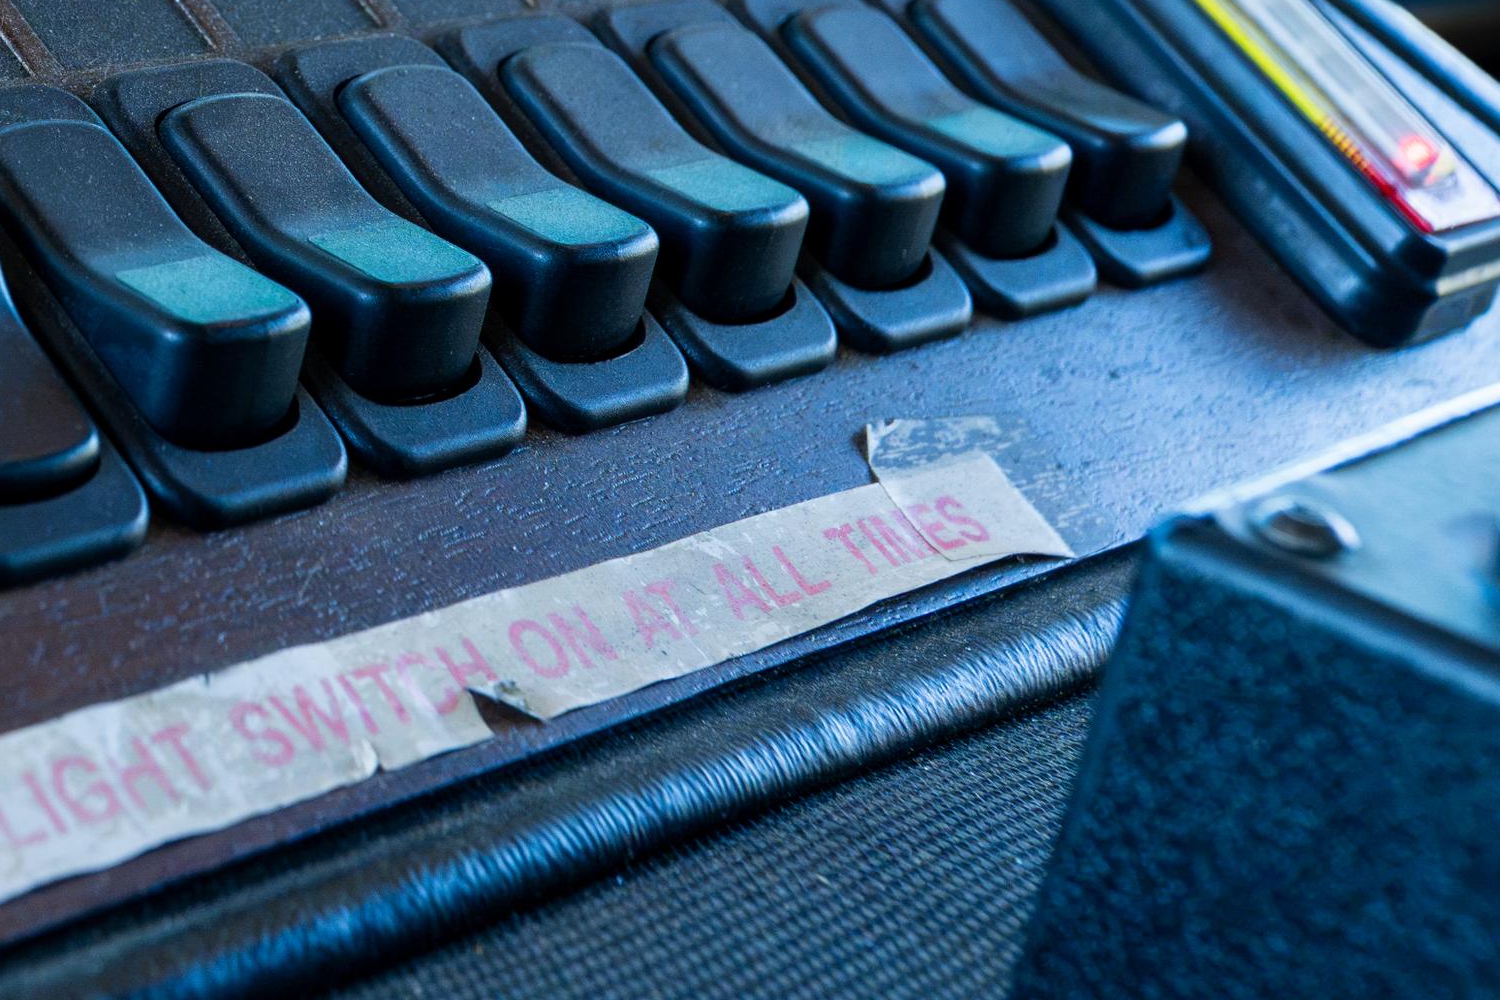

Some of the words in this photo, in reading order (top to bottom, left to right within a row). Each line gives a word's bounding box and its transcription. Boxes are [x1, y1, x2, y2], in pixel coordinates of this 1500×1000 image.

[229, 637, 499, 767] SWITCH
[507, 603, 619, 680] ON
[624, 577, 700, 649] AT
[712, 545, 833, 621] ALL
